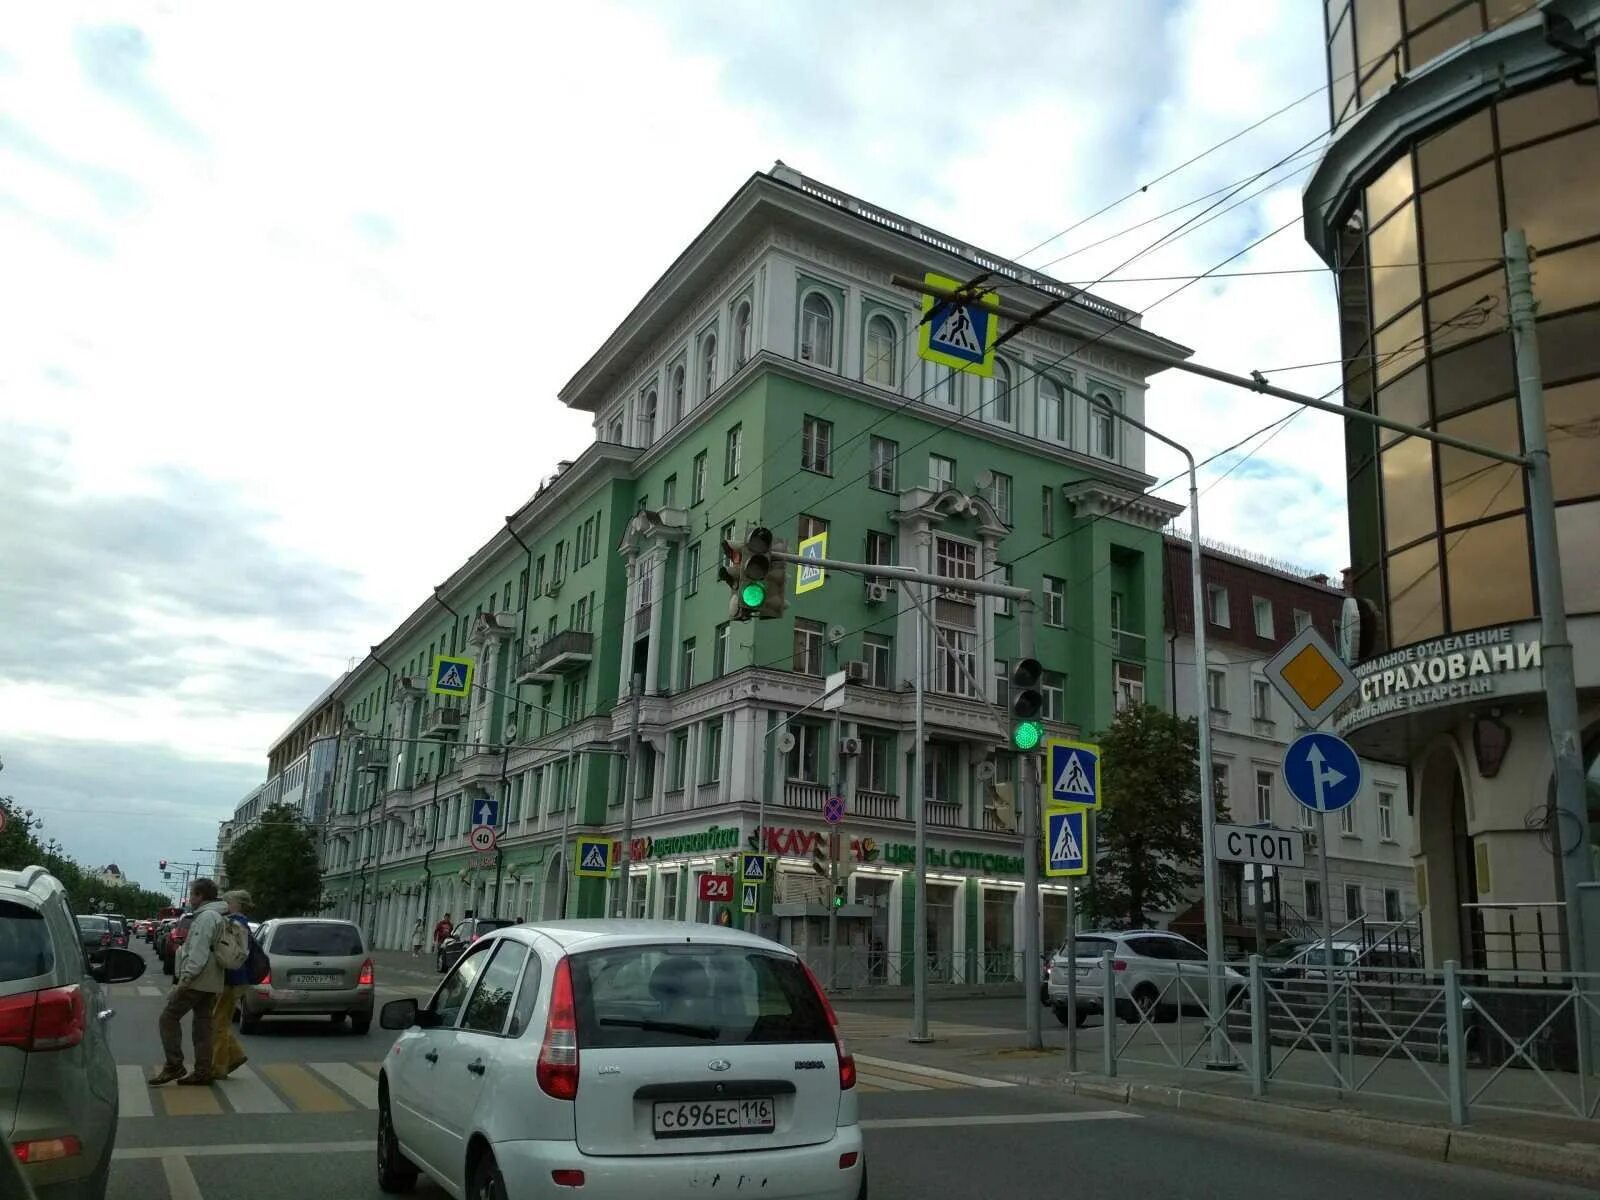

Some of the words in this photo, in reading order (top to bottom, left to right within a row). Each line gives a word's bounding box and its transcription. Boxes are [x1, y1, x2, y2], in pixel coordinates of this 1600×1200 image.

[1417, 628, 1510, 656] ОТДЕЛЕНИЕ
[1361, 641, 1541, 702] СТРАХОВАНИ
[1407, 678, 1491, 705] ТАТАРСТАН
[476, 833, 490, 844] 40
[767, 827, 865, 862] КЛУА
[1227, 831, 1293, 861] СТОП
[706, 879, 728, 897] 24
[662, 1104, 739, 1128] С696ЕС
[742, 1101, 770, 1119] 116
